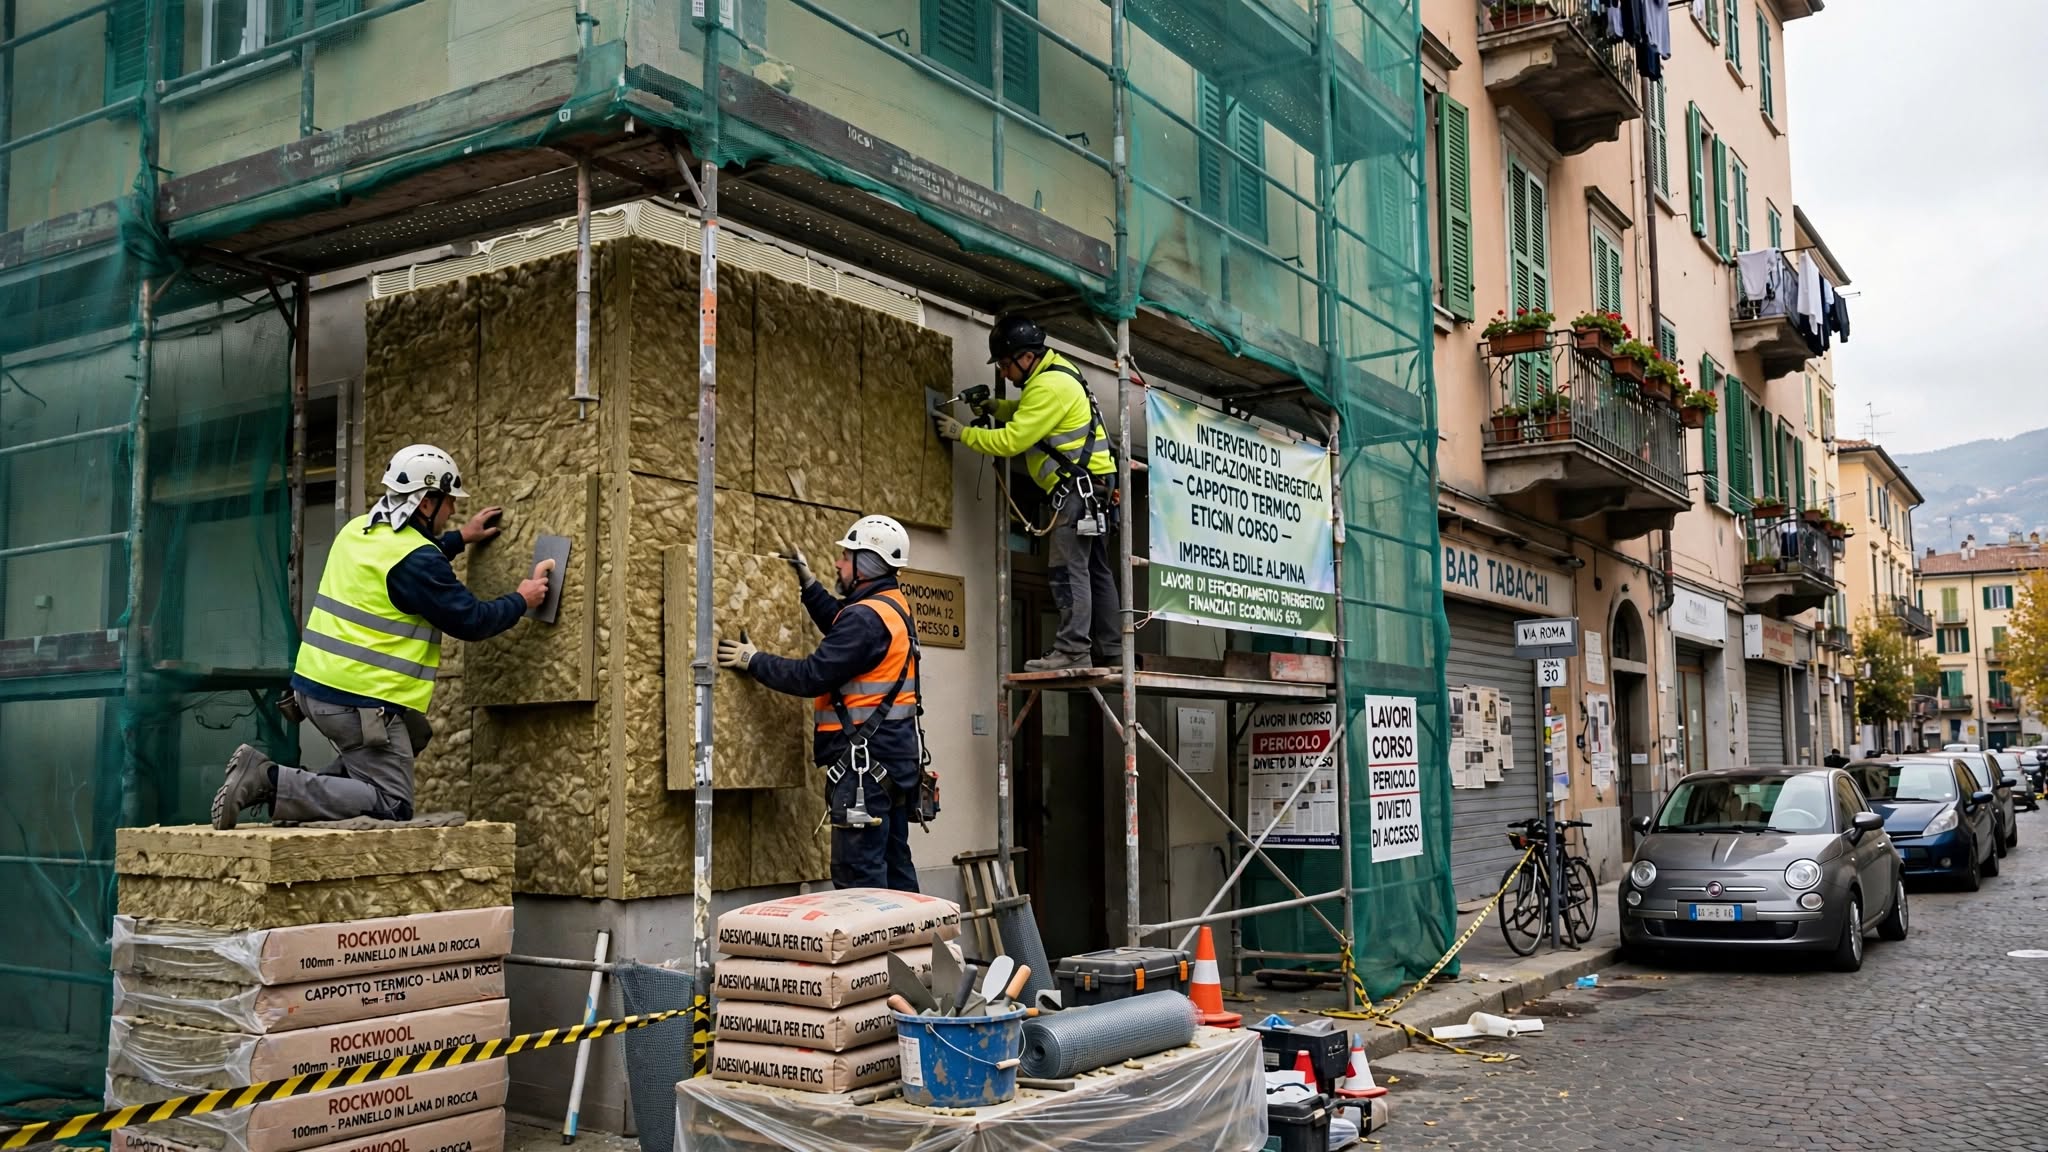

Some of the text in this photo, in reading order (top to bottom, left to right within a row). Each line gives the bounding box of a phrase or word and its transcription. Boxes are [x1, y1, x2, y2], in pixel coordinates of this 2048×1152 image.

[1197, 423, 1281, 468] INTERVENTO DI
[1155, 436, 1323, 502] RIQUALIFICAZIONE ENERGETICA
[1186, 474, 1249, 510] CAPPOTTO
[1252, 492, 1301, 523] TERMICO
[1237, 516, 1278, 543] CORSO
[1179, 541, 1305, 585] IMPRESA EDILE ALPINA
[1446, 546, 1479, 589] BAR
[900, 583, 954, 602] CONDOMINIO
[1160, 571, 1194, 591] LAVORI
[1197, 577, 1206, 593] DI
[1281, 591, 1325, 611] ENERGETICO
[916, 603, 954, 620] ROMA 12
[916, 620, 960, 638] GRESSO B
[1540, 626, 1566, 639] ROMA
[1544, 669, 1559, 682] 30
[1253, 711, 1332, 728] LAVORI IN CORSO
[1370, 705, 1412, 729] LAVORI
[1260, 735, 1320, 752] PERICOLO
[1372, 735, 1413, 759] CORSO
[1288, 756, 1297, 768] DI
[1373, 769, 1416, 790] PERICOLO
[1377, 799, 1412, 821] DIVIETO
[1372, 824, 1420, 848] DI ACCESSO
[338, 926, 421, 949] ROCKWOOL
[719, 928, 823, 953] ADESIVO-MALTA PER ETICS
[300, 957, 334, 970] 100mm
[344, 948, 396, 965] PANNELLO
[398, 946, 408, 958] IN
[411, 943, 436, 956] LANA
[438, 941, 448, 953] DI
[450, 938, 481, 951] ROCCA
[305, 982, 371, 1002] CAPPOTTO
[374, 975, 424, 992] TERMICO
[432, 971, 460, 984] LANA
[462, 967, 472, 980] DI
[718, 974, 822, 997] ADESIVO-MALTA PER ETICS
[330, 1025, 415, 1053] ROCKWOOL
[720, 1015, 825, 1040] ADESIVO-MALTA PER ETICS
[292, 1062, 328, 1076] 100mm
[338, 1048, 391, 1068] PANNELLO
[393, 1047, 403, 1058] IN
[406, 1044, 431, 1056] LANA
[434, 1039, 444, 1051] DI
[446, 1034, 477, 1049] ROCCA
[856, 1056, 895, 1077] CAPPOTTO
[716, 1057, 823, 1084] ADESIVO-MALTA PER ETICS
[329, 1085, 414, 1115] ROCKWOOL
[291, 1125, 328, 1139] 100mm
[338, 1109, 392, 1130] PANNELLO
[394, 1106, 404, 1119] IN
[407, 1102, 433, 1116] LANA
[435, 1098, 445, 1110] DI
[447, 1091, 478, 1106] ROCCA
